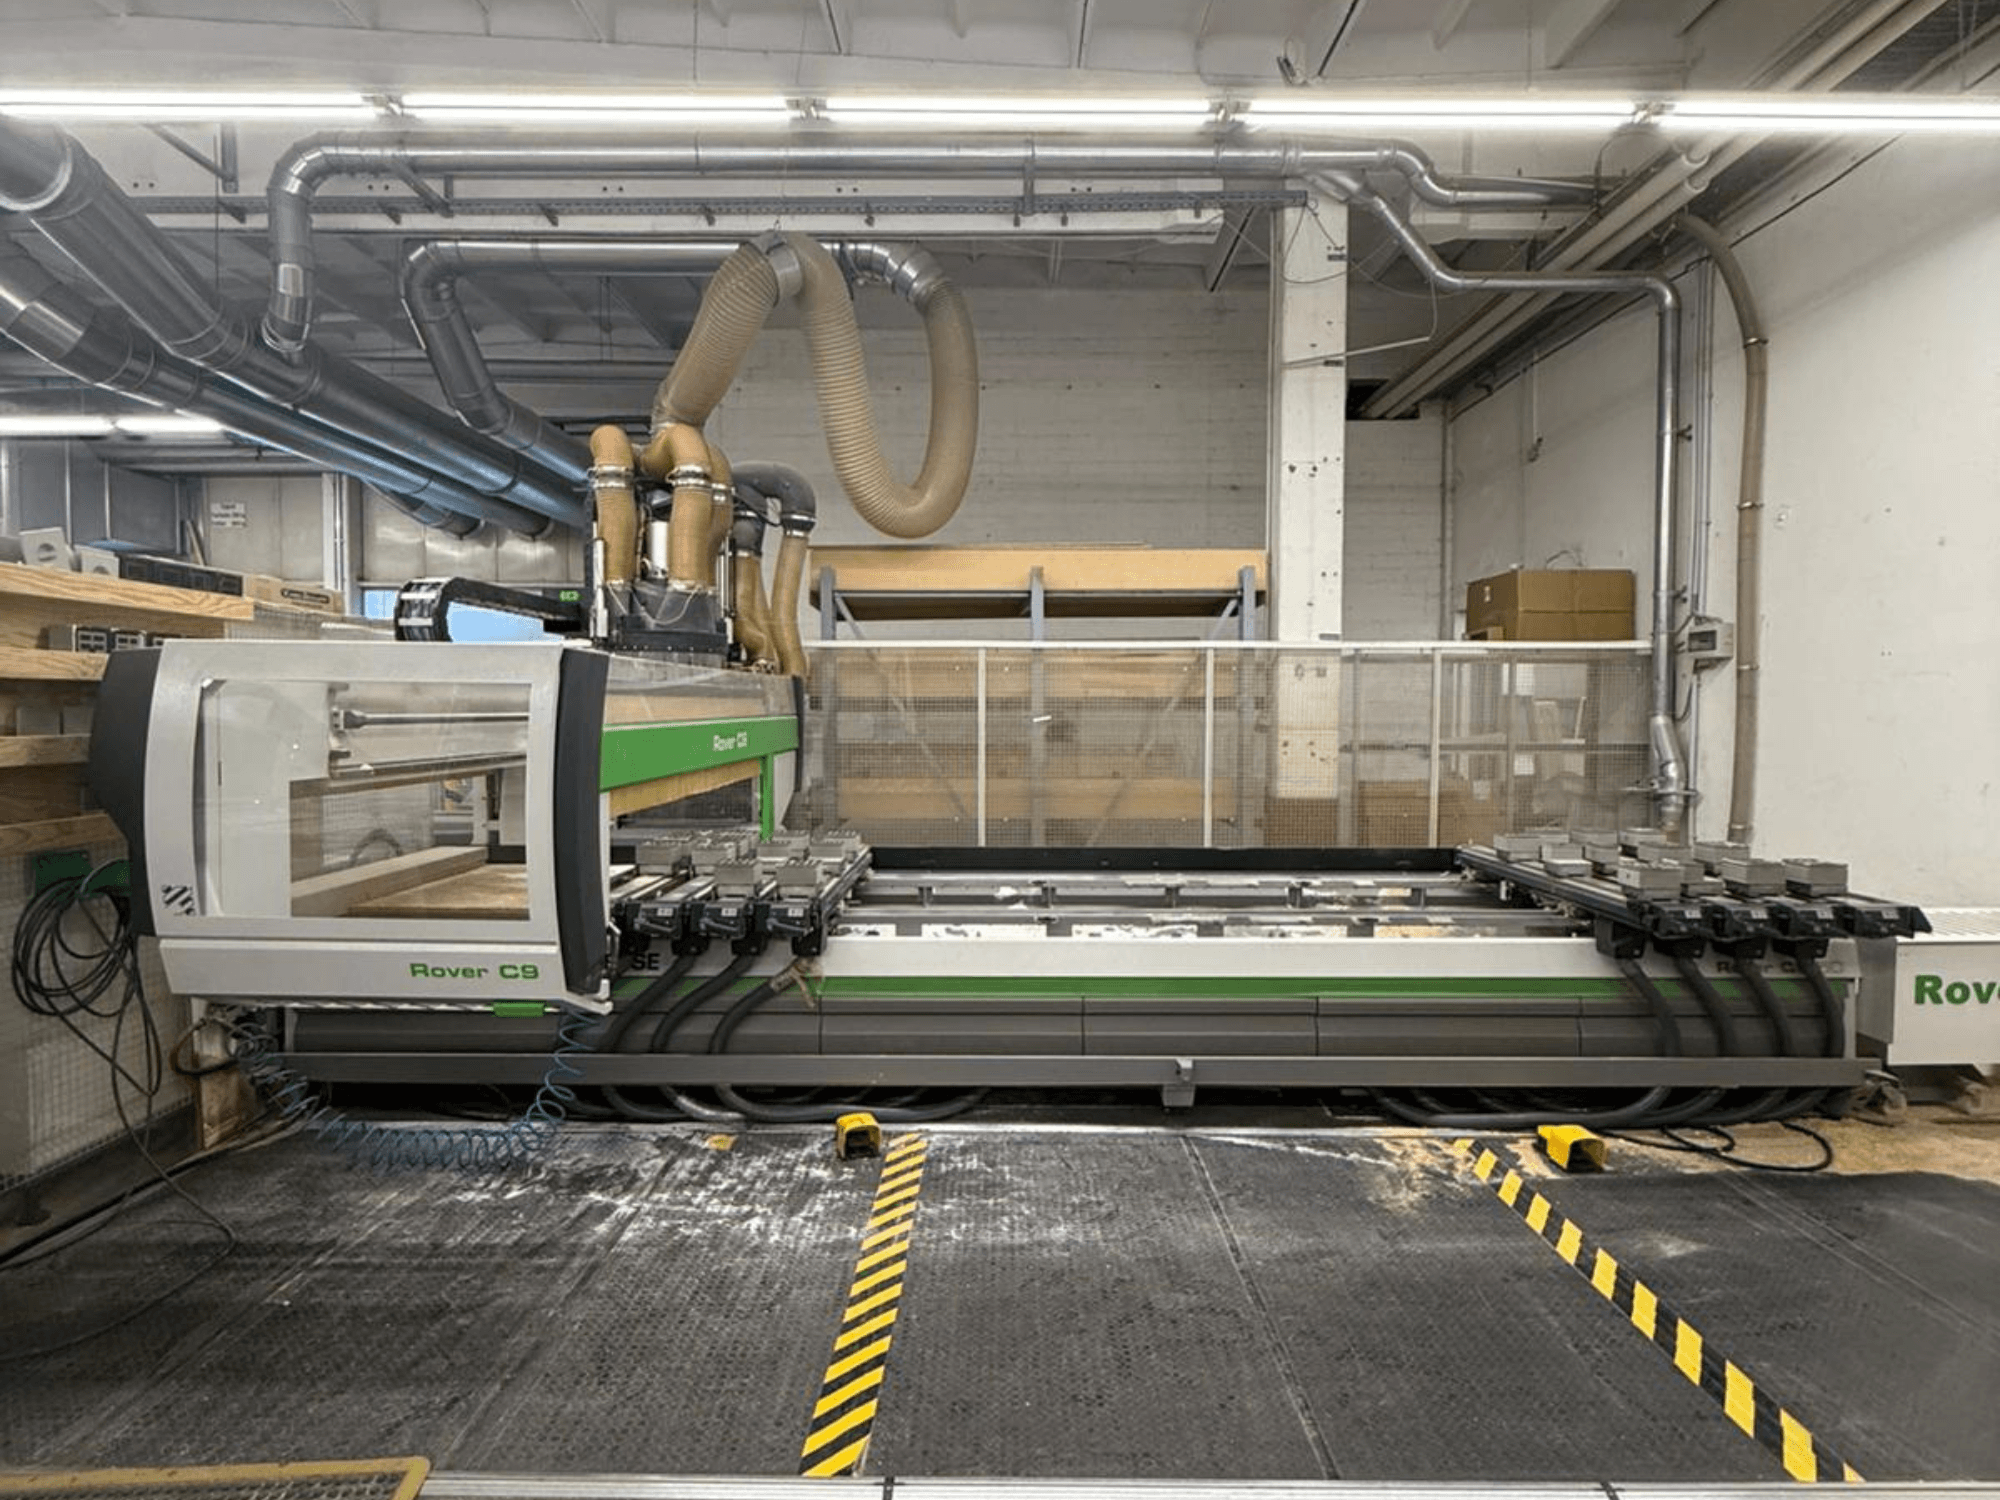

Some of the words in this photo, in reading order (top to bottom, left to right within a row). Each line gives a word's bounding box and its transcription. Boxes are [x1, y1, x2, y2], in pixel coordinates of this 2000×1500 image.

[409, 963, 488, 978] Rover
[499, 964, 540, 979] C9
[1914, 974, 2000, 1005] Rov
